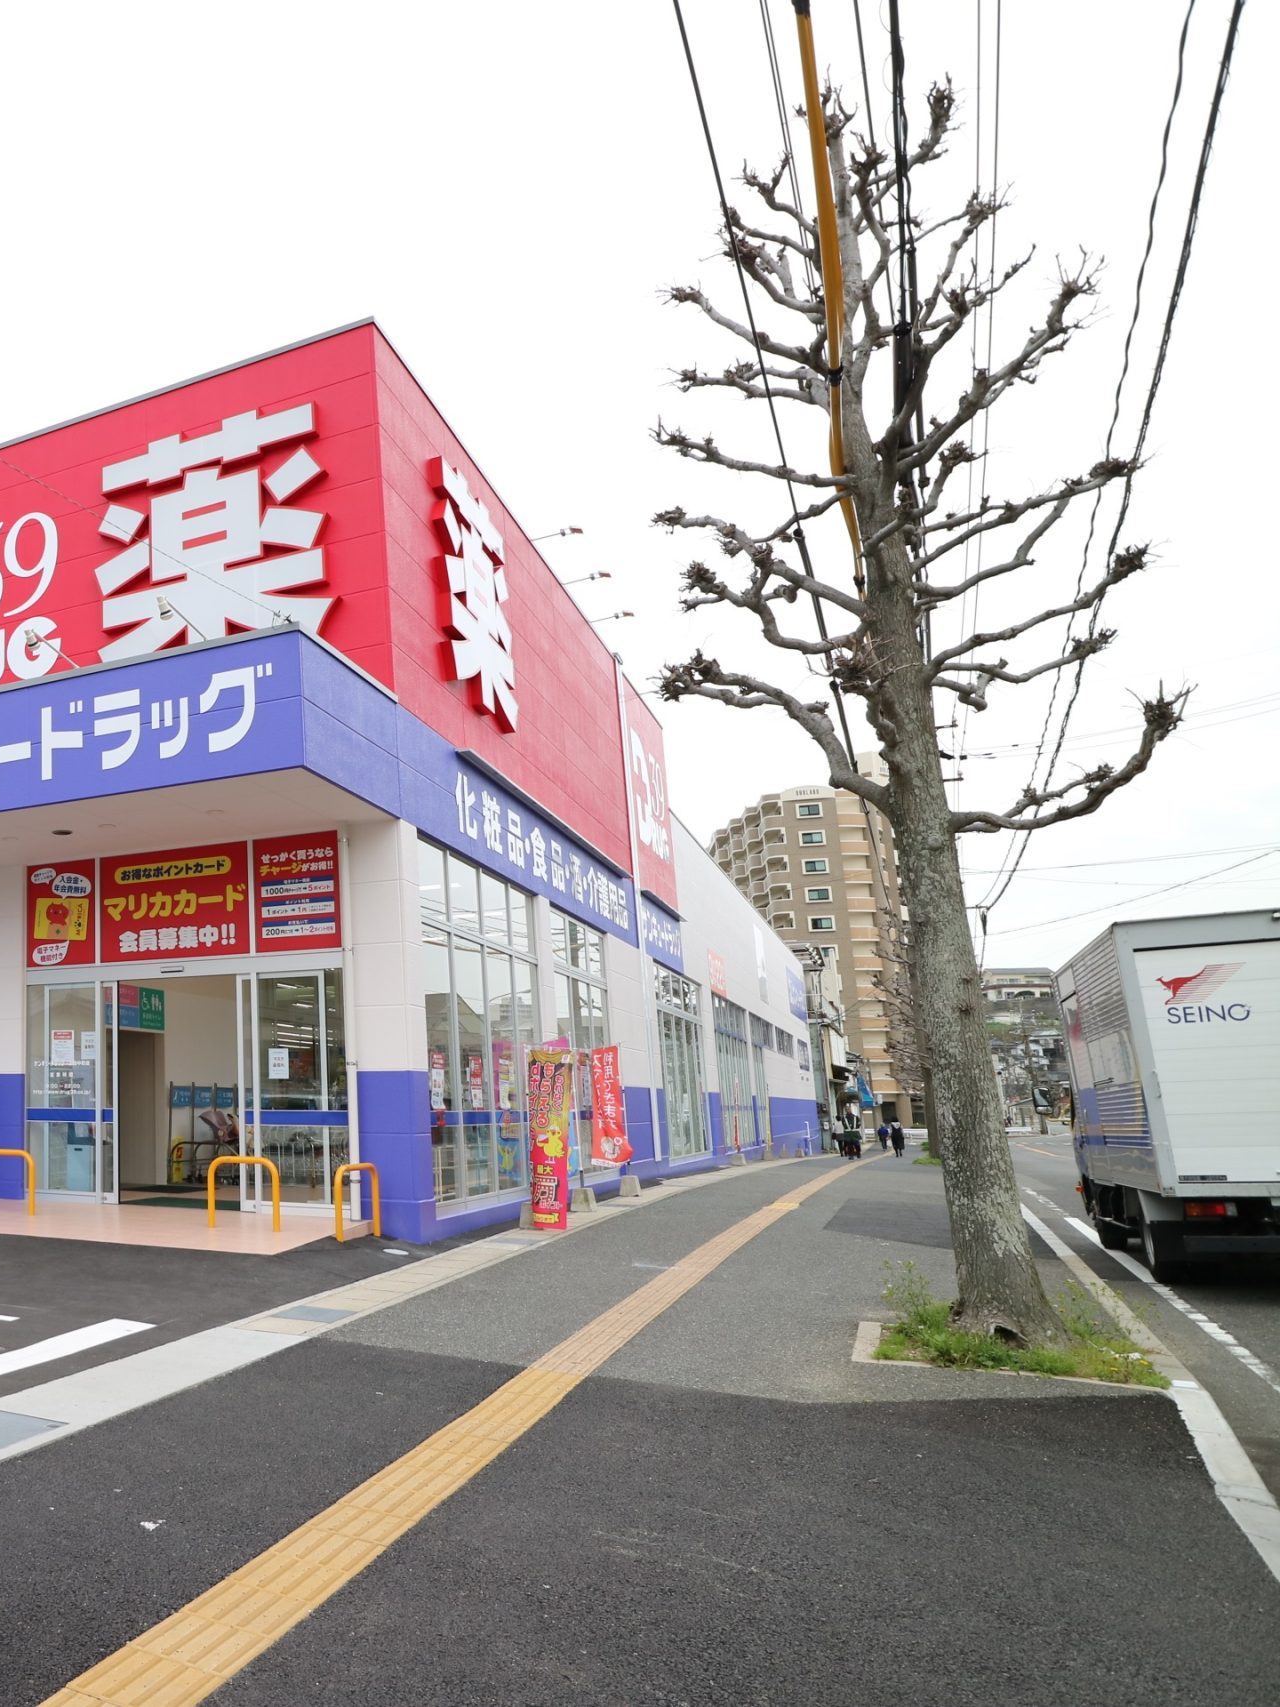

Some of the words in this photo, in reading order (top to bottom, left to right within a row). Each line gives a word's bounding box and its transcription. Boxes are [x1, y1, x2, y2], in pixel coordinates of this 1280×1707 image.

[95, 402, 338, 664] 薬
[434, 456, 519, 733] 薬
[648, 753, 665, 820] 39
[120, 860, 225, 881] お得なポイントカード
[261, 847, 334, 863] せっかく買うなら
[103, 883, 246, 922] マリカカード
